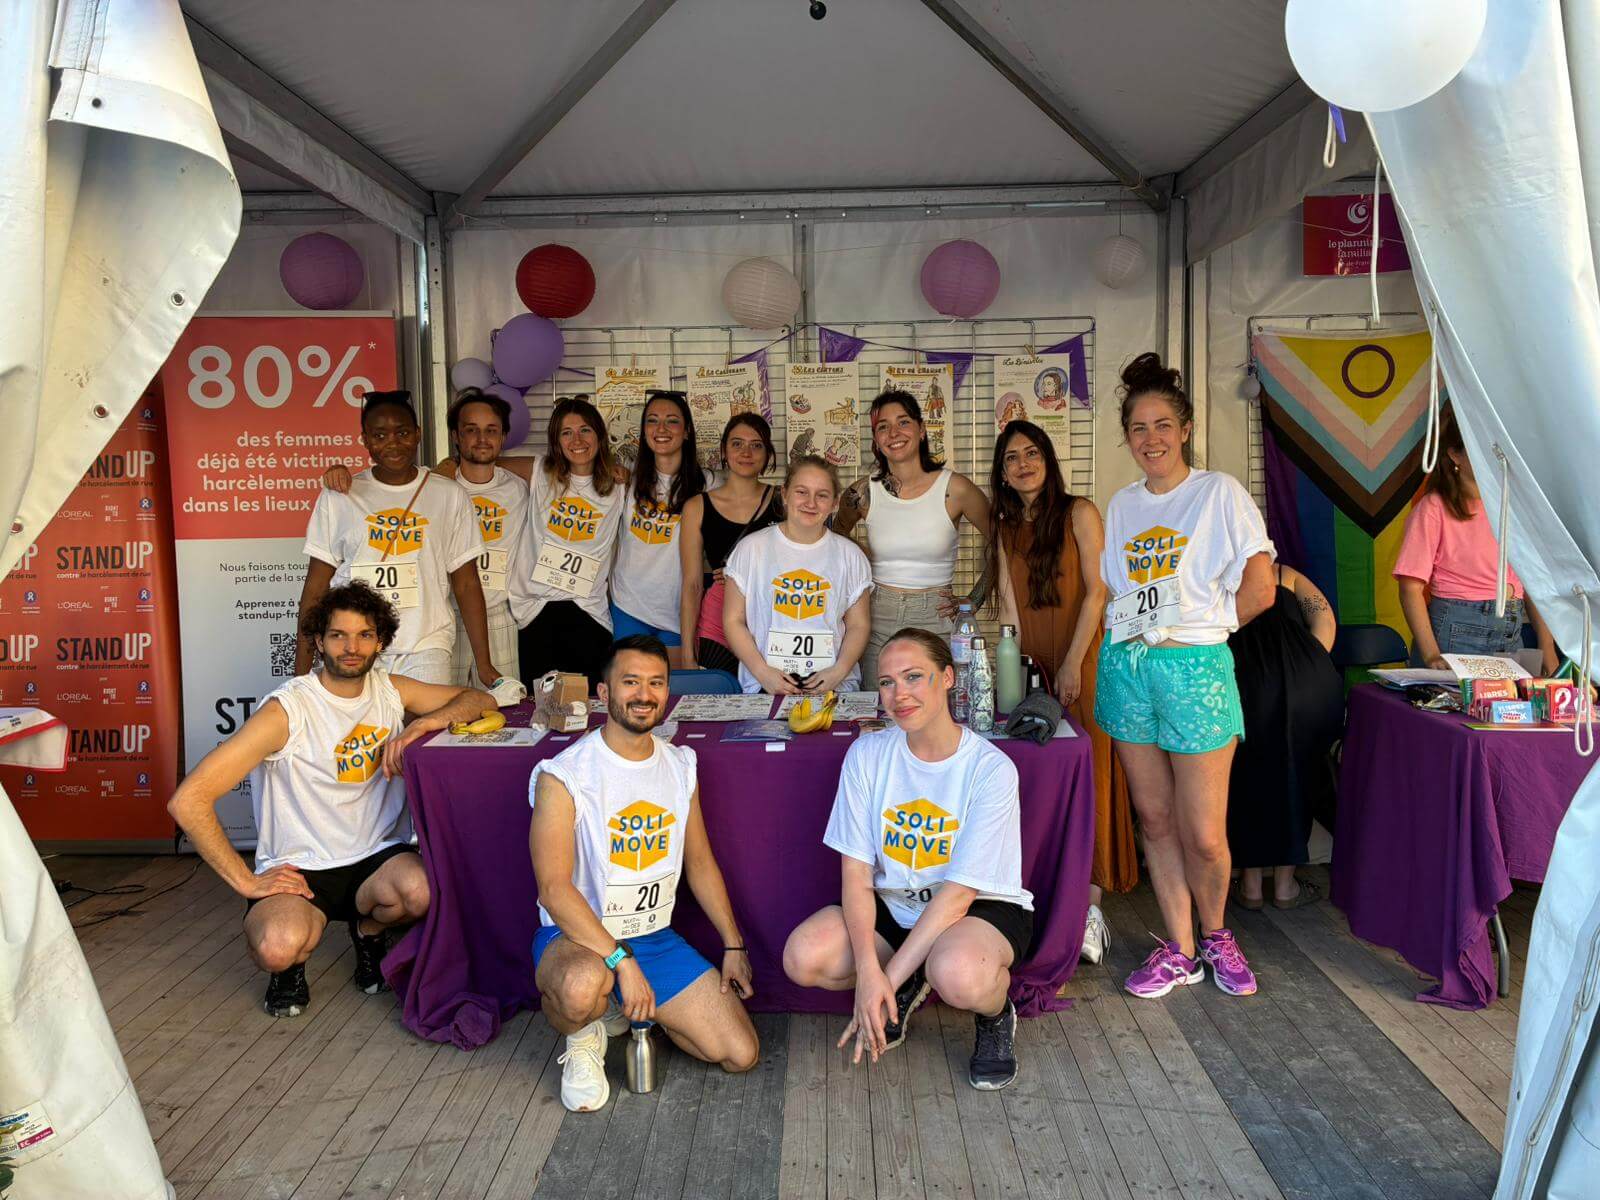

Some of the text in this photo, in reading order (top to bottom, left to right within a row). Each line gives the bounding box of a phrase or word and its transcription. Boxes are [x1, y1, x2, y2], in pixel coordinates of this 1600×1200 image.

[1328, 239, 1383, 249] le plannig
[236, 431, 270, 447] des
[275, 431, 352, 446] femmes
[197, 453, 240, 473] déjà
[245, 453, 277, 469] été
[282, 453, 362, 468] victimes
[203, 474, 325, 490] harcèlement
[183, 496, 311, 513] dans les lieux
[558, 501, 594, 520] SOLI
[375, 514, 418, 527] SOLI
[548, 514, 596, 534] MOVE
[631, 516, 672, 538] MOVE
[369, 529, 423, 542] MOVE
[1132, 536, 1175, 552] SOLI
[56, 541, 153, 570] STANDUP
[560, 552, 582, 575] 20
[1128, 554, 1179, 572] MOVE
[219, 562, 246, 572] Nous
[248, 562, 285, 571] faisons
[234, 574, 266, 585] partie
[269, 574, 281, 582] de
[284, 573, 294, 581] la
[375, 566, 398, 588] 20
[781, 578, 820, 591] SOLI
[236, 598, 295, 610] Apprenez à
[775, 593, 824, 607] MOVE
[1137, 586, 1159, 615] 20
[56, 633, 152, 661] STANDUP
[792, 635, 814, 656] 20
[341, 732, 379, 754] SOLI
[619, 814, 663, 832] SOLI
[895, 810, 944, 832] SOLI
[611, 835, 667, 854] MOVE
[885, 831, 949, 855] MOVE
[635, 883, 660, 912] 20
